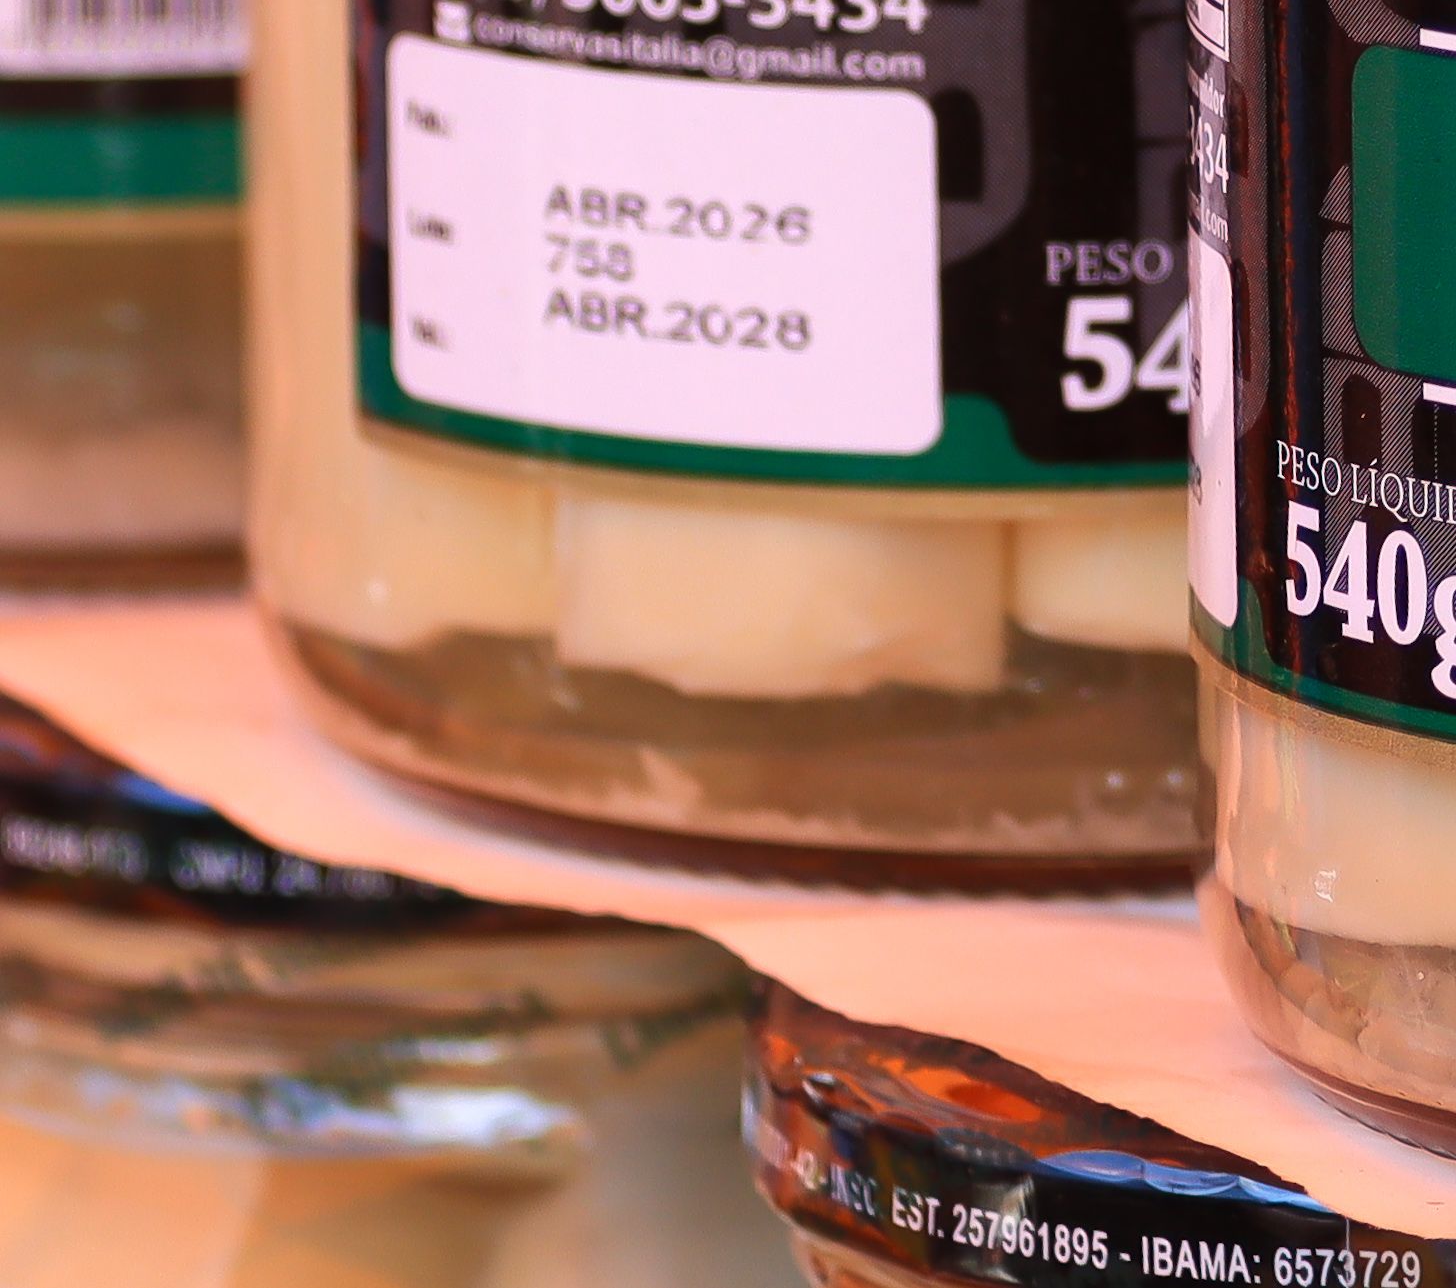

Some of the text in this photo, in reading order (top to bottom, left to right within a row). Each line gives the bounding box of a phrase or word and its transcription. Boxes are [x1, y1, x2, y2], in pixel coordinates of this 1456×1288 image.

[472, 13, 926, 83] conservasitalia@gmail.com
[1045, 241, 1174, 287] PESO
[1276, 439, 1343, 497] PESO
[892, 1186, 945, 1238] EST.
[953, 1204, 1108, 1271] 257961895
[1142, 1235, 1262, 1286] IBAMA:
[1273, 1247, 1422, 1288] 6573729
